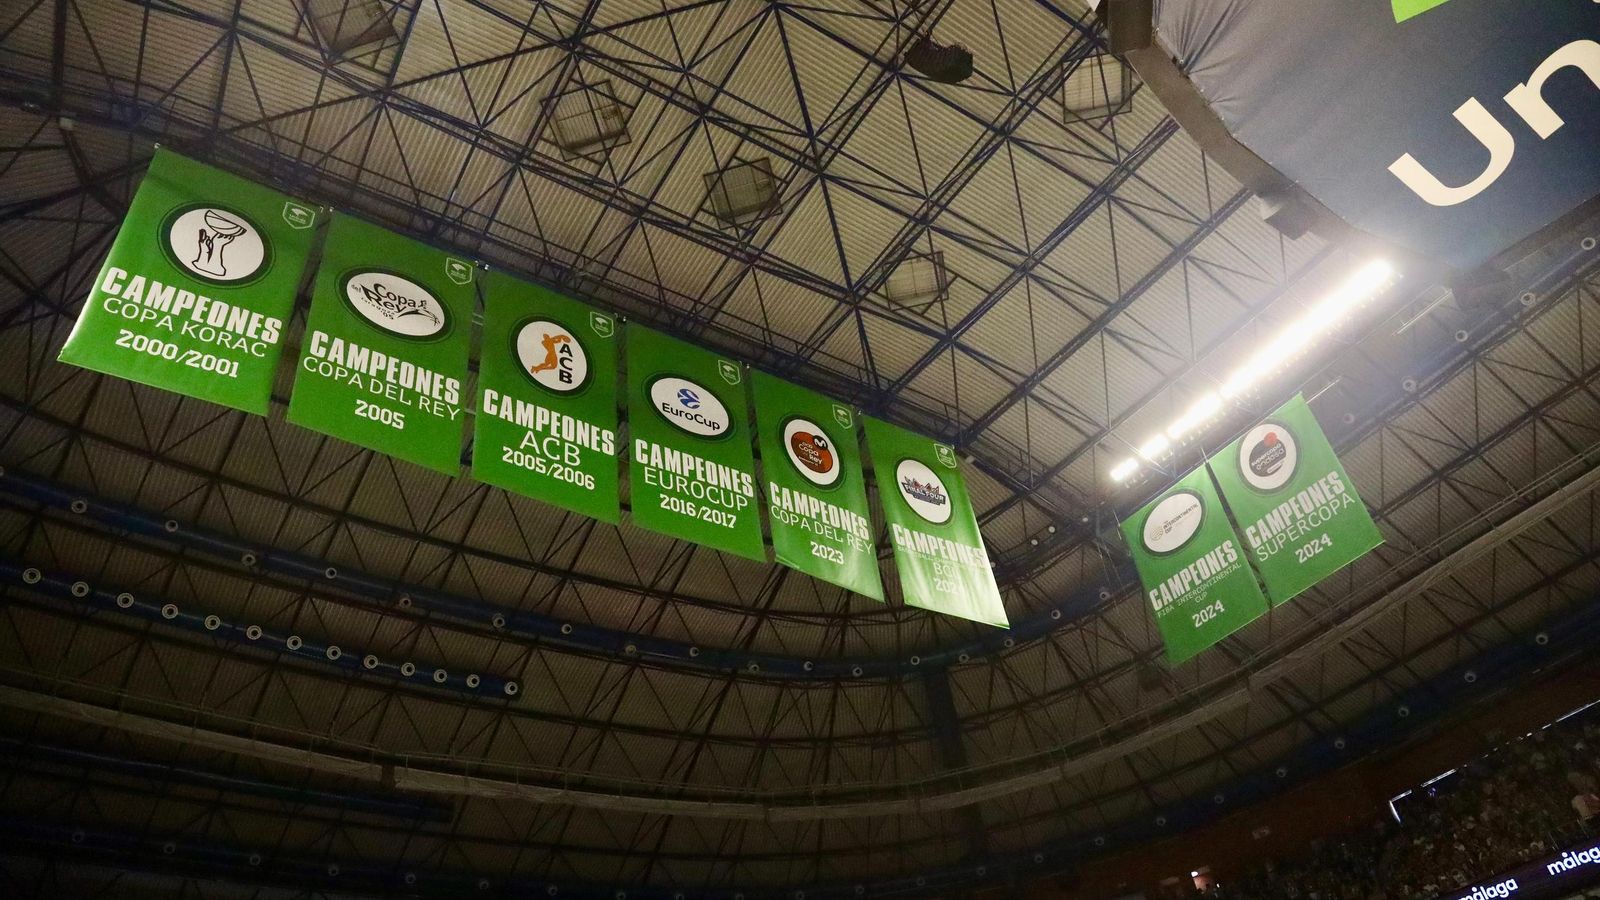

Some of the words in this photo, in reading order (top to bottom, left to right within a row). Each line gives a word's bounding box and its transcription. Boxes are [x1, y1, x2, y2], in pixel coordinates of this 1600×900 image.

[101, 267, 283, 345] CAMPEONES
[360, 284, 407, 313] Rey
[373, 283, 417, 307] Copa
[103, 297, 173, 332] COPA
[180, 320, 268, 358] KORAC
[115, 329, 239, 378] 2000/2001
[310, 330, 460, 405] CAMPEONES
[558, 343, 573, 385] ACB
[303, 357, 364, 389] COPA
[369, 379, 412, 406] DEL
[418, 395, 462, 422] REY
[354, 400, 405, 430] 2005
[483, 388, 615, 456] CAMPEONES
[662, 402, 721, 432] EuroCup
[502, 446, 595, 490] 2005/2006
[519, 430, 581, 467] ACB
[635, 438, 754, 498] CAMPEONES
[644, 466, 748, 511] EUROCUP
[659, 493, 737, 528] 2016/2017
[770, 481, 870, 541] CAMPEONES
[1245, 471, 1345, 550] CAMPEONES
[771, 505, 811, 532] COPA
[815, 522, 843, 543] DEL
[847, 534, 873, 555] REY
[892, 523, 986, 569] CAMPEONES
[1256, 492, 1356, 562] SUPERCOPA
[1295, 533, 1333, 564] 2024
[810, 541, 844, 565] 2023
[1149, 539, 1238, 611] CAMPEONES
[1176, 562, 1242, 607] INTERCONTINENTAL
[1195, 591, 1208, 603] CUP
[1192, 600, 1225, 628] 2024
